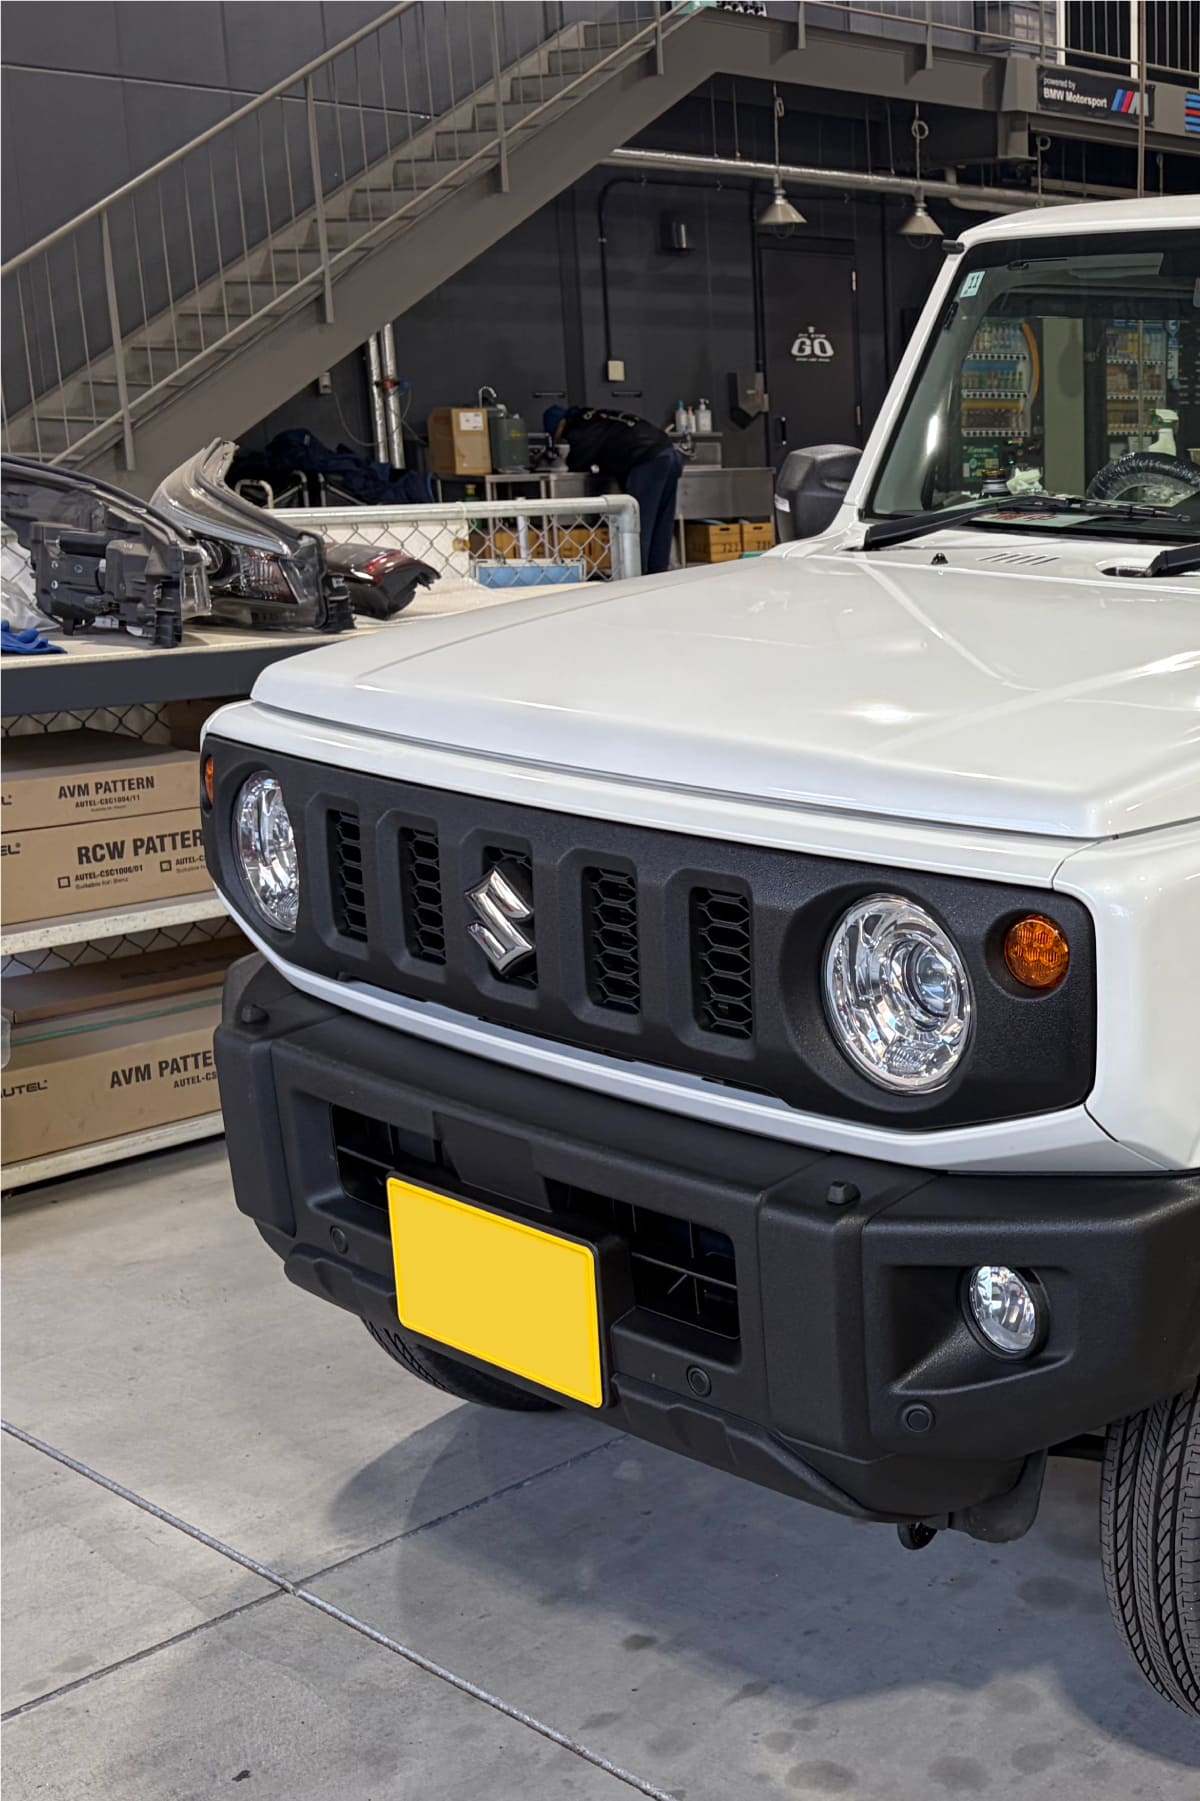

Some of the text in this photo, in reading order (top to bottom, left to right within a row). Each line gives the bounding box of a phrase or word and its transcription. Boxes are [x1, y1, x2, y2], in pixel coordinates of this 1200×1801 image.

[1069, 81, 1077, 91] by
[1043, 88, 1108, 109] BMW Motorsport
[790, 337, 834, 357] GO
[58, 776, 155, 800] AVM PATTERN
[77, 840, 126, 865] RCW
[110, 1062, 151, 1089] AVM
[1, 1081, 48, 1099] UTEL
